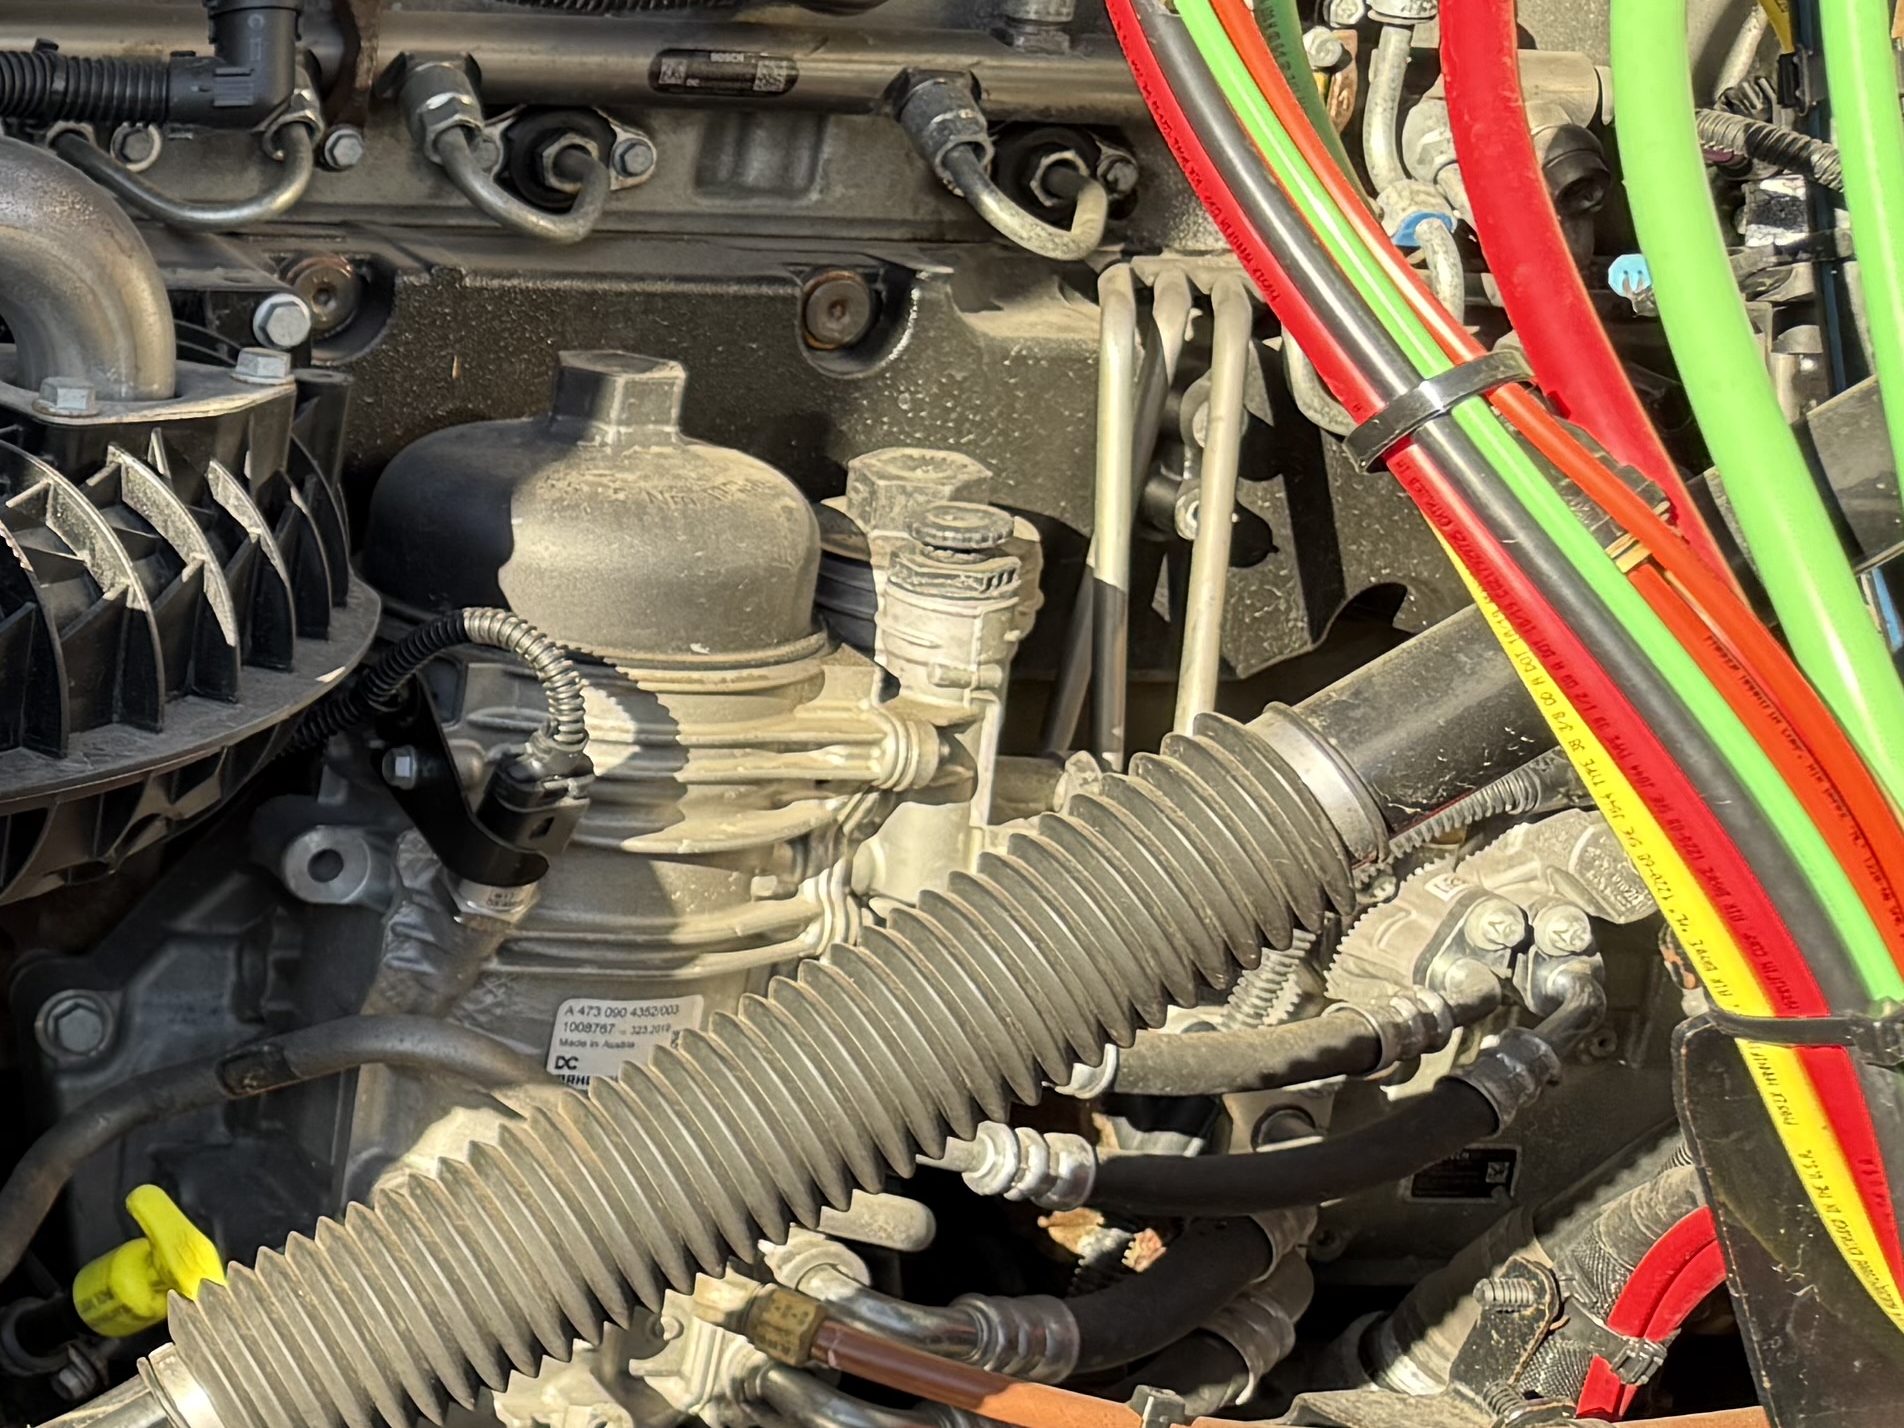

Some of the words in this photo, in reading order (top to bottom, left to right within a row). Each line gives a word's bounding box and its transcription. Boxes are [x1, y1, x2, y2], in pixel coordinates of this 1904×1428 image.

[1515, 648, 1537, 674] DOT
[1530, 674, 1544, 686] A
[1572, 688, 1597, 715] 1/2
[1551, 708, 1574, 734] 3/8
[1604, 732, 1633, 763] TYPE
[1580, 756, 1605, 787] TYPE
[1621, 824, 1643, 850] SAE
[1709, 974, 1732, 1000] AIR
[565, 1006, 575, 1017] A
[577, 1005, 602, 1017] 473
[604, 1006, 627, 1018] 090
[559, 1038, 587, 1048] Made
[589, 1038, 599, 1048] in
[602, 1041, 635, 1049] Austria
[555, 1055, 579, 1070] DC
